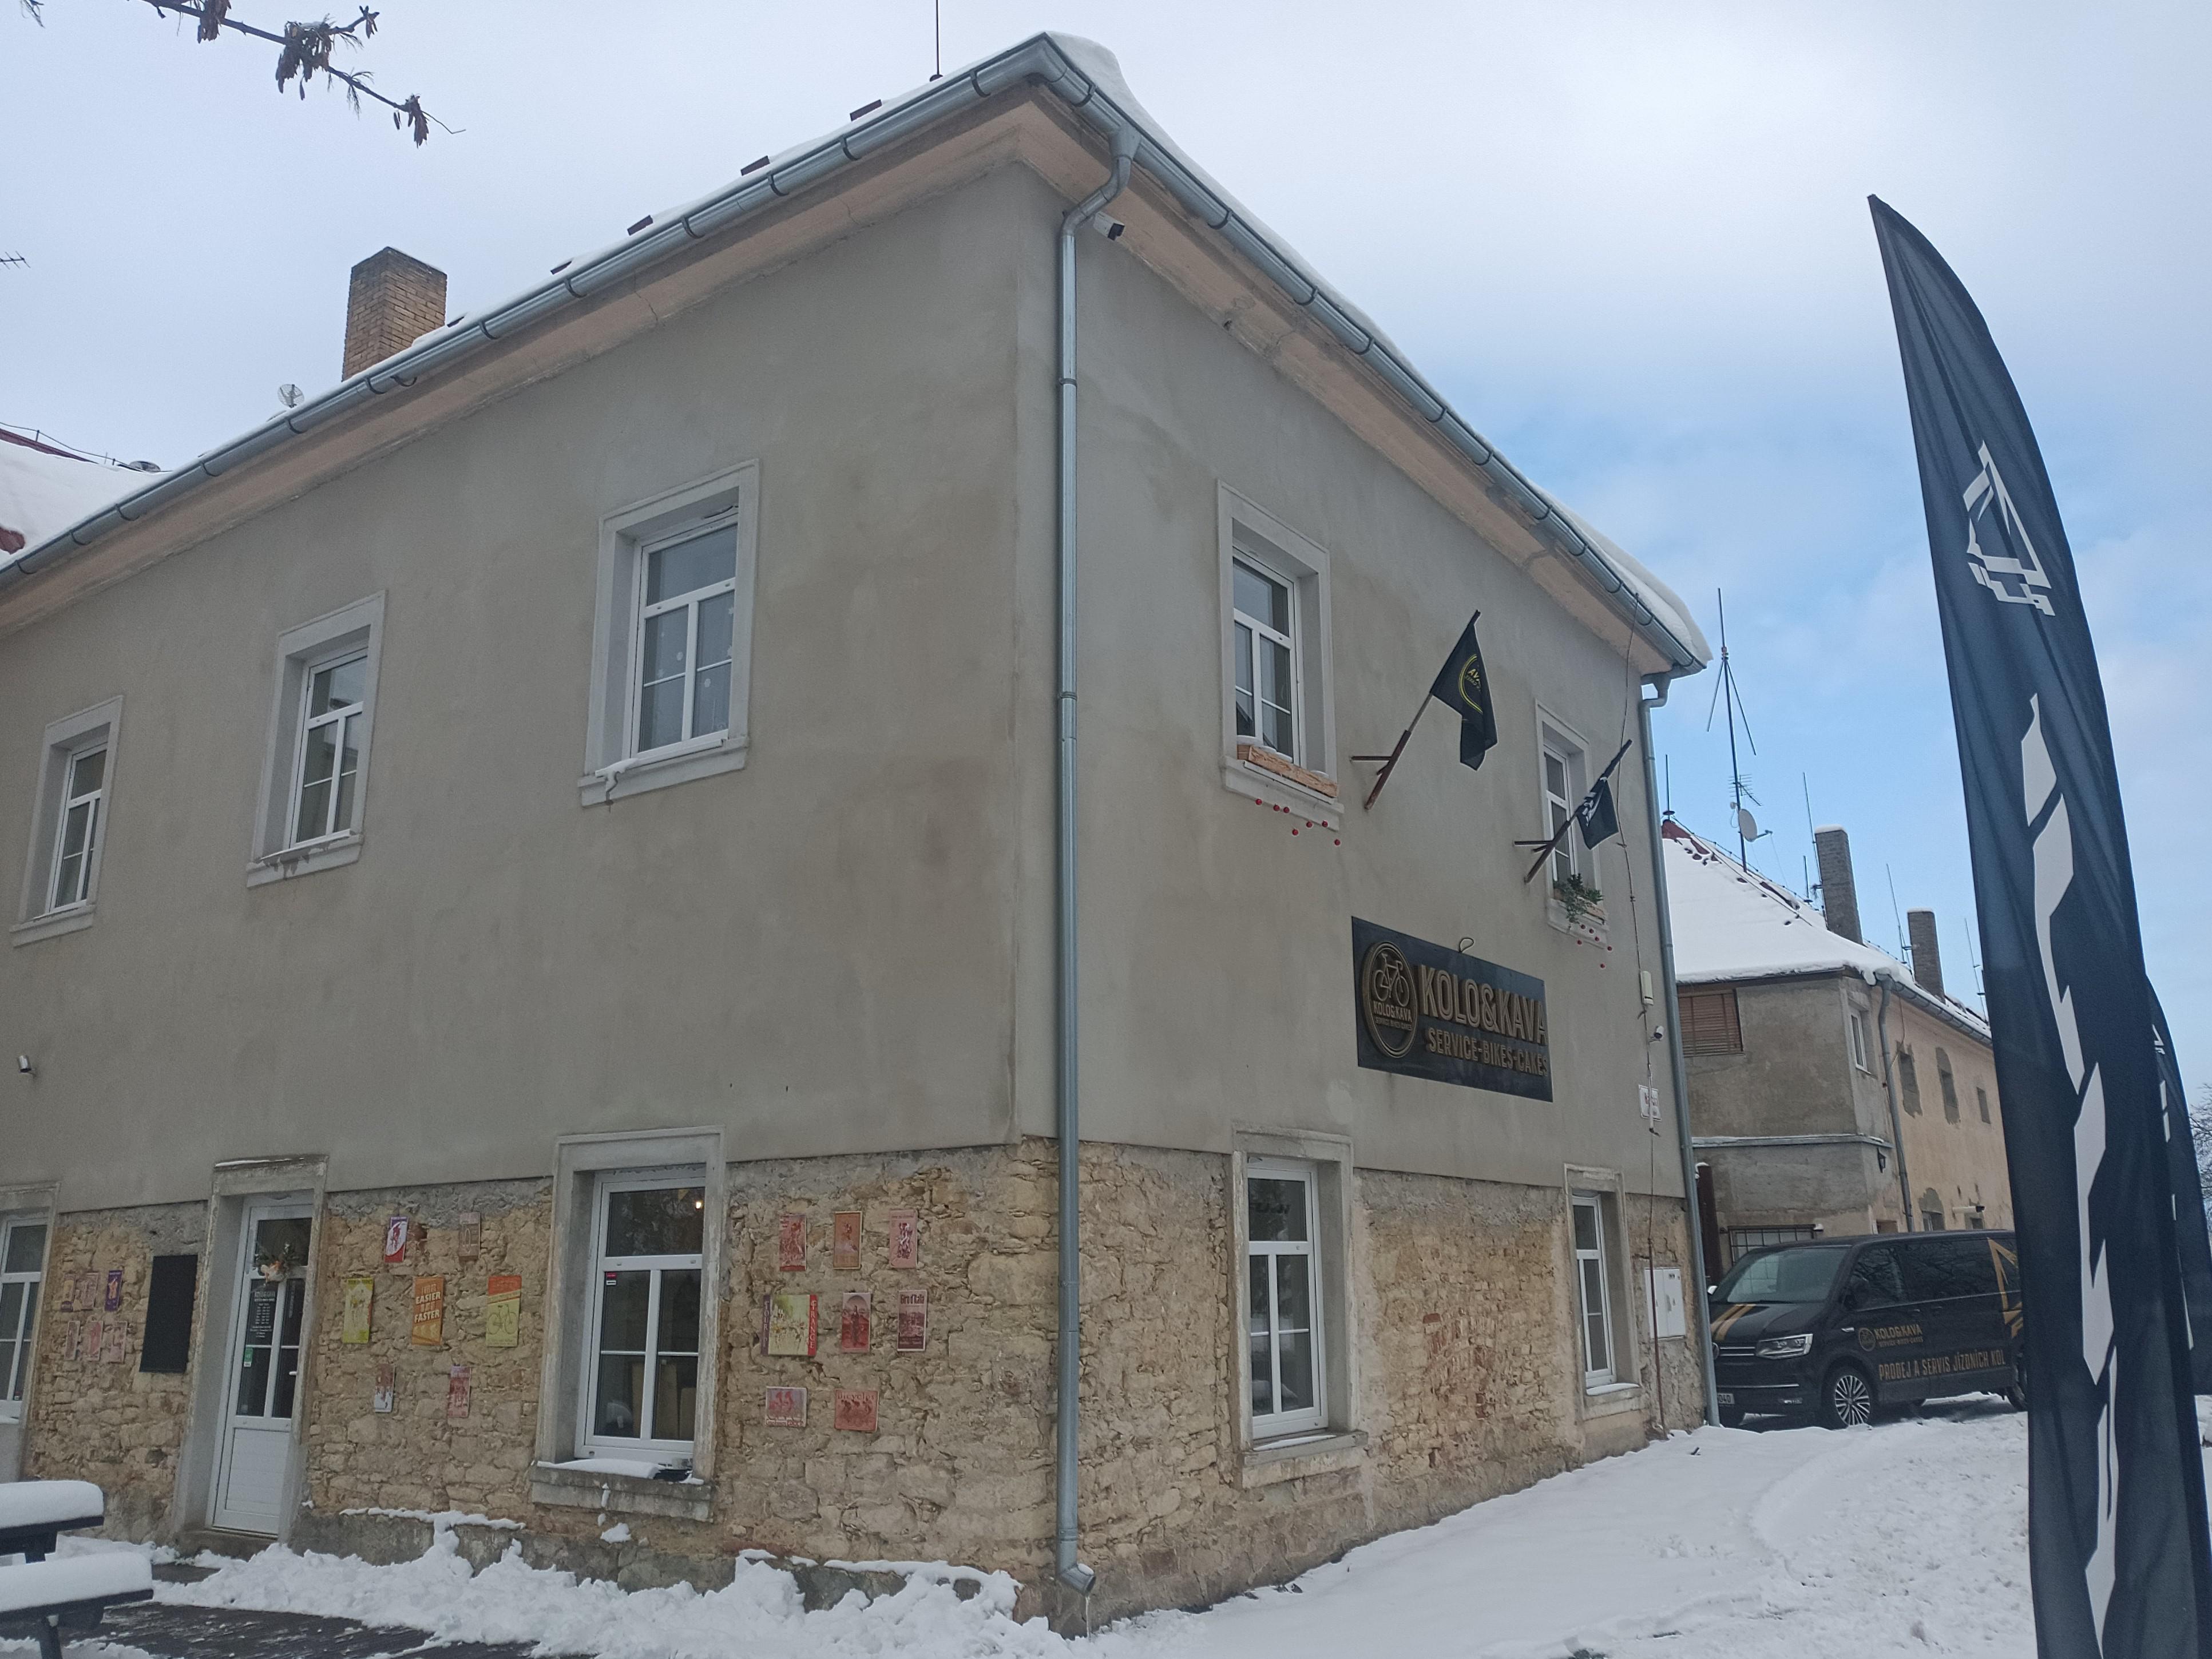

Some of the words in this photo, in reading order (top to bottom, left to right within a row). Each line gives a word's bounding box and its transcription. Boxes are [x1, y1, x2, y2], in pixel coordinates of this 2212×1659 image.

[1374, 1001, 1412, 1023] KOLO&KAVA
[1418, 965, 1547, 1046] KOLO&KAVA
[416, 1292, 441, 1304] EASIER
[414, 1309, 440, 1323] FASTER
[1874, 1324, 1922, 1340] KOLO&KAVA
[1878, 1361, 1911, 1381] PRODEJ
[1914, 1360, 1920, 1377] A
[1922, 1356, 1951, 1375] SERVIS
[1953, 1349, 1989, 1371] JÍZDNÍCH
[1991, 1350, 2006, 1366] KOL
